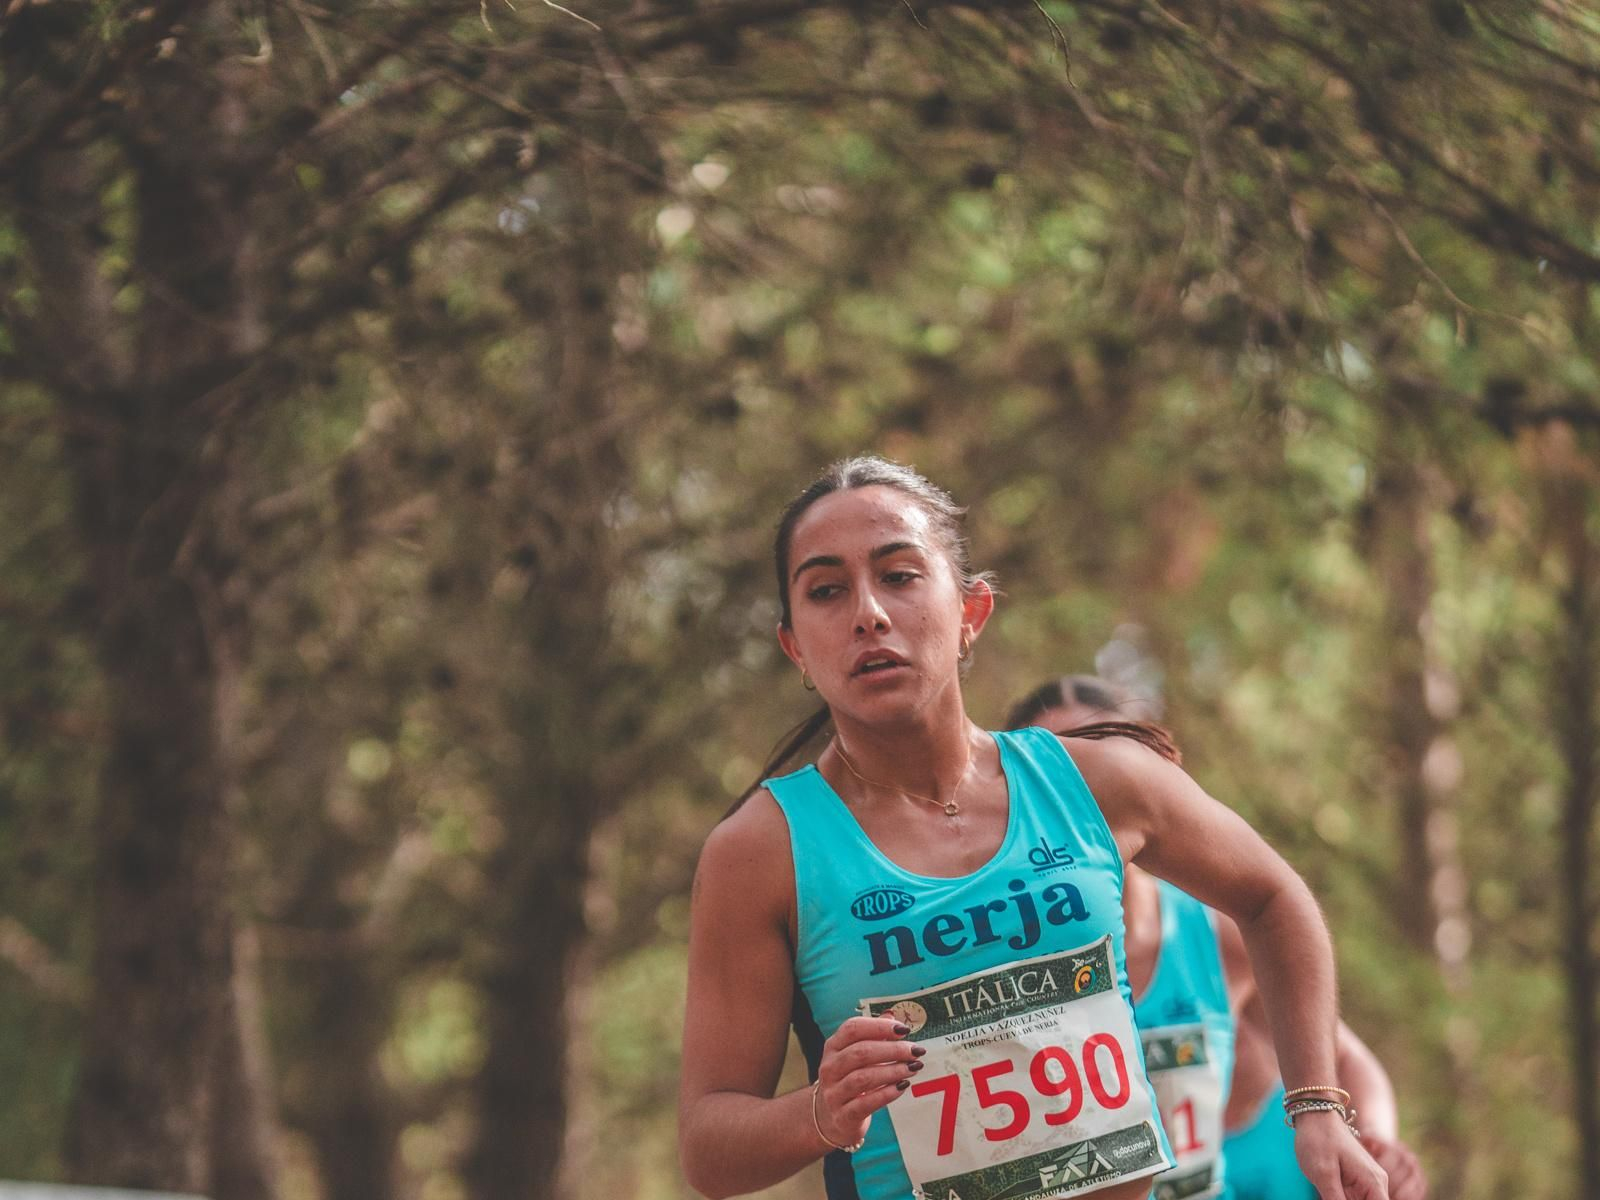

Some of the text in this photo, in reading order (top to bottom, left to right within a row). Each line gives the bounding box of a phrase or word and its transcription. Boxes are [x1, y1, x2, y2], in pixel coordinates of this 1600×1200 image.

[853, 891, 912, 917] TROPS
[863, 879, 1091, 976] nerja
[943, 968, 1058, 1018] ITÁLICA
[945, 1028, 986, 1045] NOELIA
[911, 1032, 1131, 1156] 7590
[1081, 1171, 1122, 1187] ATLETISMO
